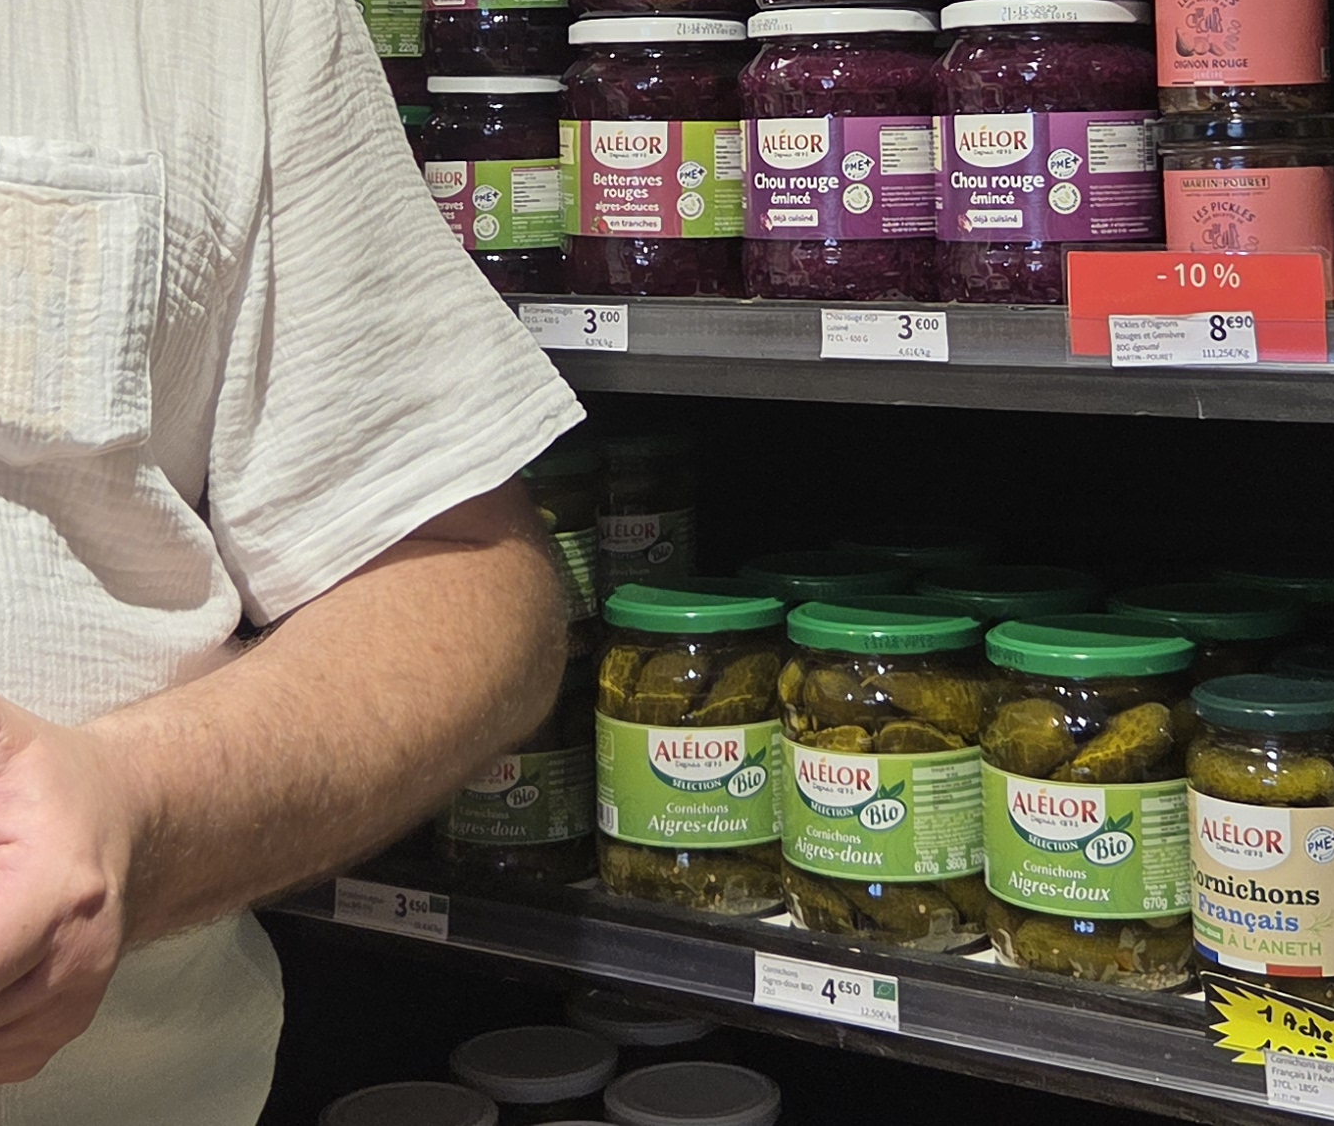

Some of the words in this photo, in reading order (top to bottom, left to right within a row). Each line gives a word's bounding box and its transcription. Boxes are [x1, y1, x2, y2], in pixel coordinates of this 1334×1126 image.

[1174, 59, 1209, 69] OIGNON
[1212, 58, 1249, 68] ROUGE
[593, 172, 663, 187] Betteraves
[753, 173, 788, 191] Chou
[791, 174, 839, 193] rouge
[950, 171, 988, 190] Chou
[992, 172, 1045, 192] rouge
[603, 186, 649, 200] rouges
[1210, 202, 1256, 222] PICKLES
[1174, 263, 1207, 287] 10
[1213, 263, 1240, 288] %
[583, 309, 597, 334] 3
[600, 311, 620, 322] €00
[898, 315, 913, 340] 3
[915, 318, 939, 330] €00
[1209, 314, 1227, 341] 8
[1226, 316, 1253, 328] €90
[655, 735, 740, 763] ALÉLOR
[1012, 788, 1099, 825] ALÉLOR
[647, 815, 749, 837] Aigres-doux
[1200, 815, 1285, 855] ALÉLOR
[795, 835, 883, 866] Aigres-doux
[1090, 834, 1129, 861] Bio
[1008, 872, 1111, 902] Aigres-doux
[1192, 858, 1321, 906] Cornichons
[1198, 893, 1300, 933] Français
[821, 978, 837, 1005] 4
[838, 980, 861, 996] €50
